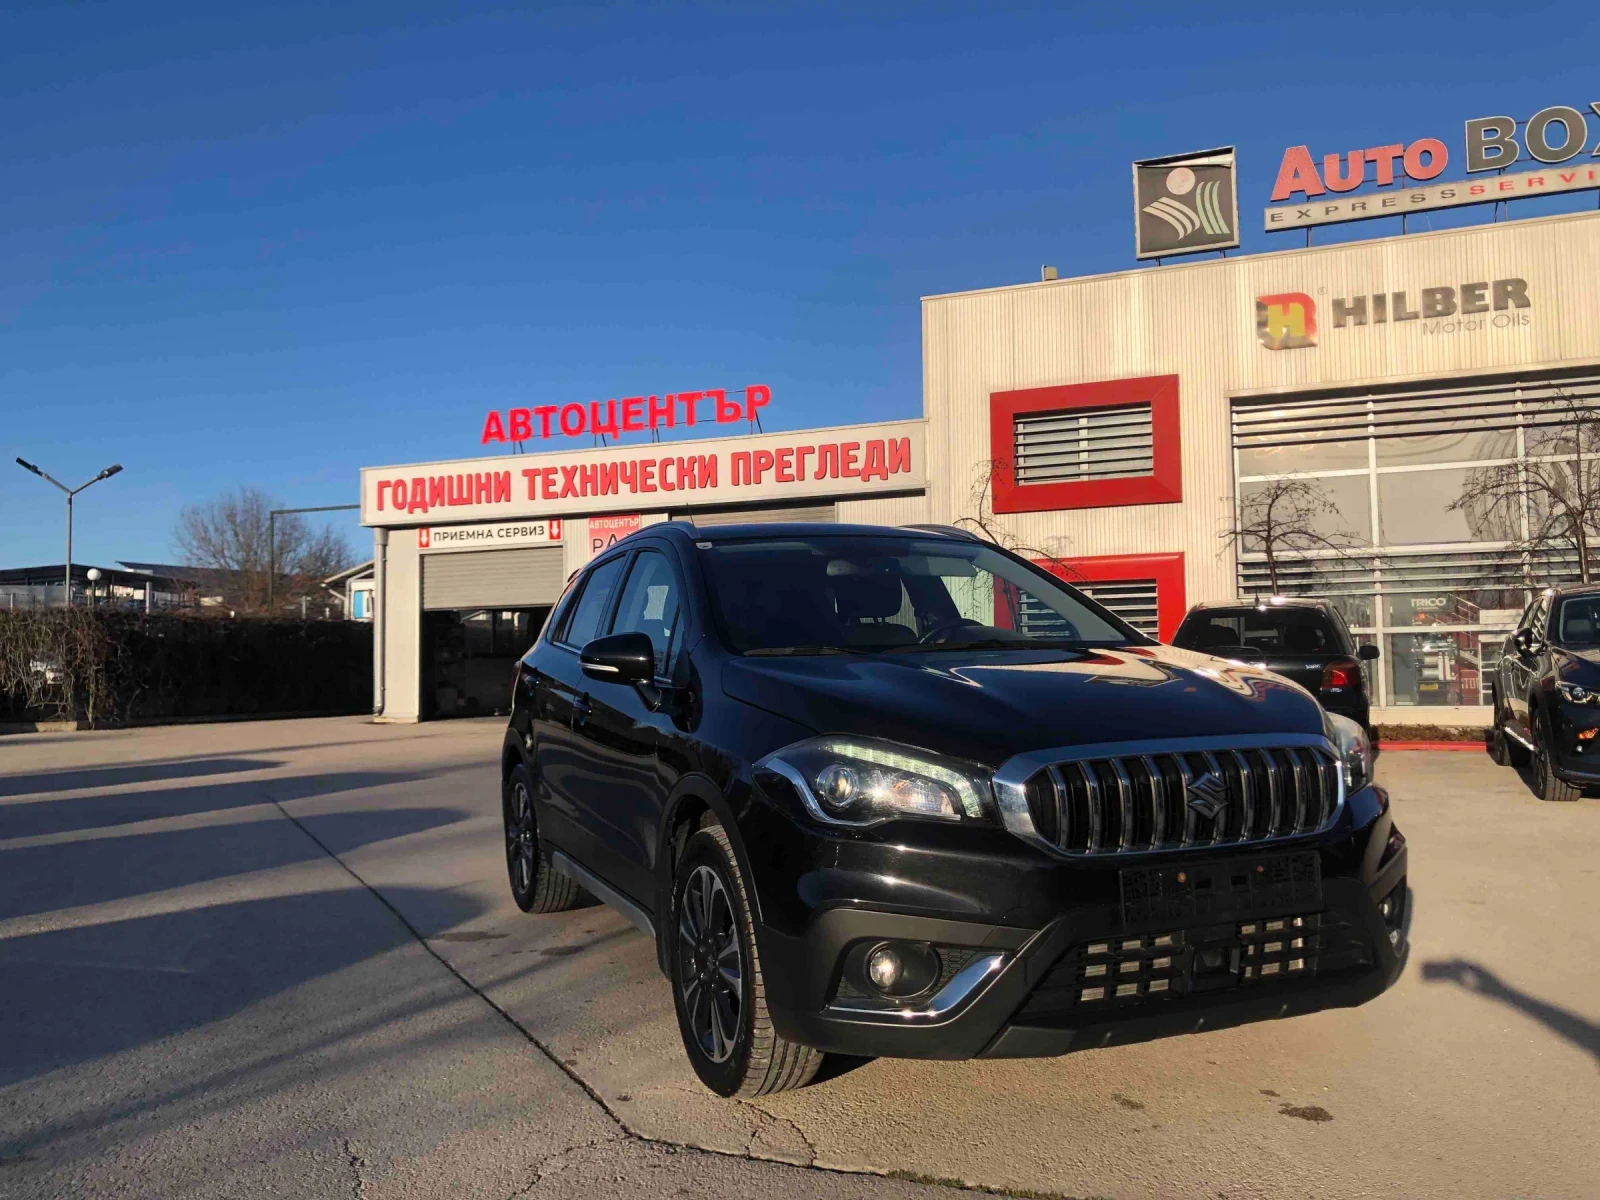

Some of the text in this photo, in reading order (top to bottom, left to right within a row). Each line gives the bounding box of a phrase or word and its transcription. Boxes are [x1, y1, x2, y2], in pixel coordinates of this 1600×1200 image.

[1465, 101, 1600, 174] BO
[1332, 277, 1531, 329] HILBER
[1422, 312, 1530, 336] Motor Oils
[481, 384, 771, 445] АВТОЦЕНТЪР
[377, 437, 911, 514] ГОДИШНИ ТЕХНИЧЕСКИ ПРЕГЛЕДИ
[433, 526, 545, 541] ПРИЕМНА СЕРВИЗ
[589, 518, 639, 529] АВТОЦЕНТЪР
[1411, 597, 1446, 607] TRICO
